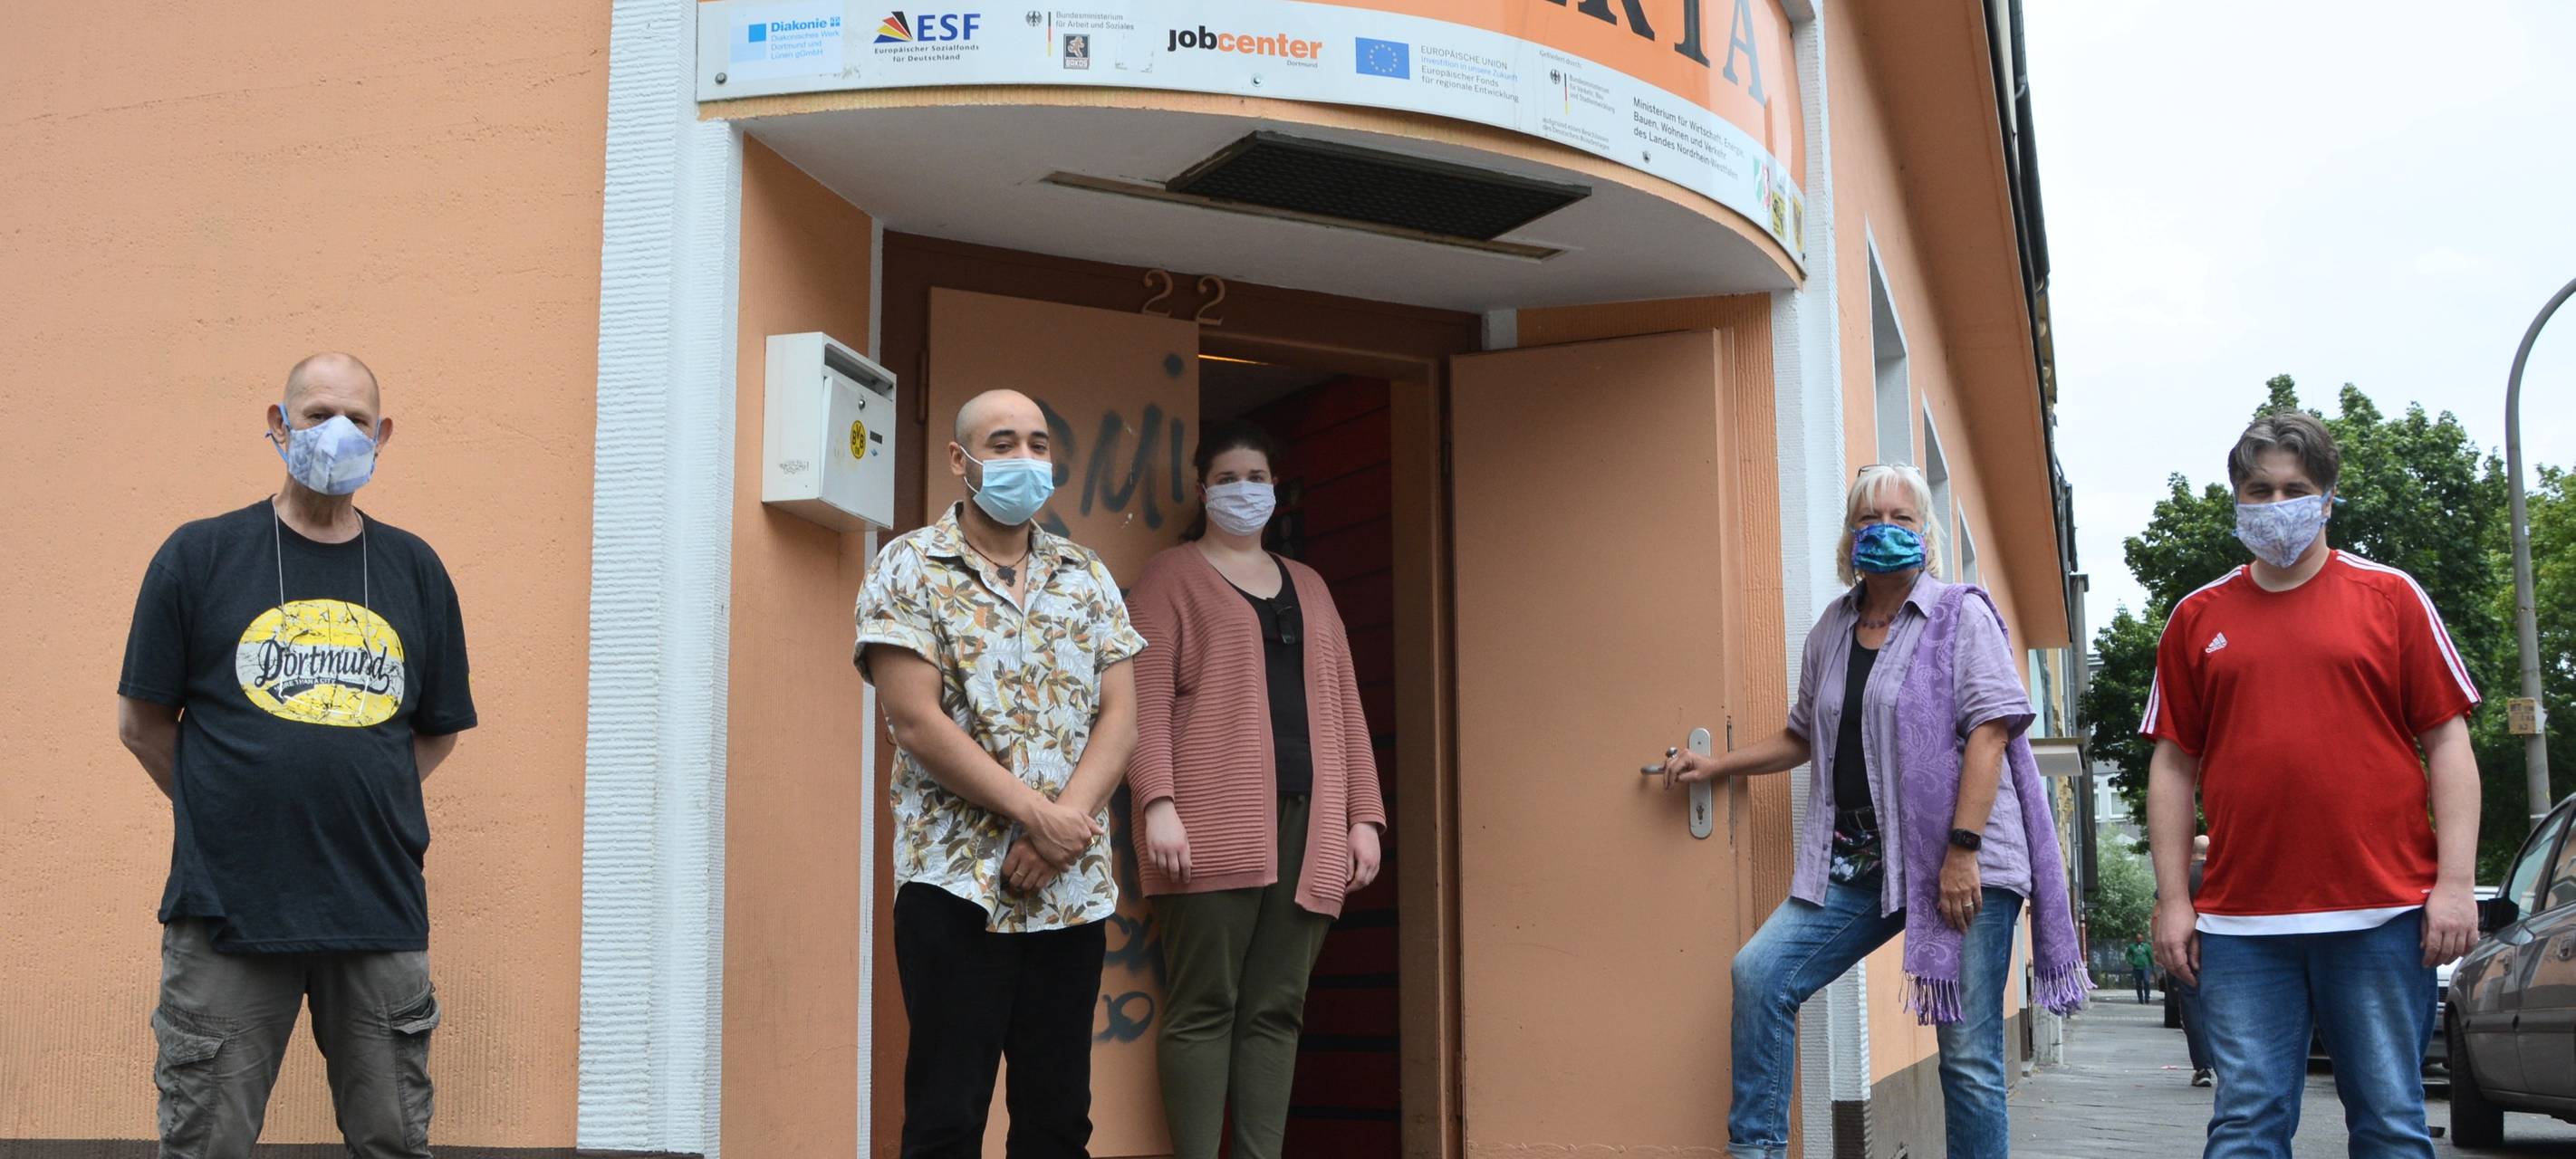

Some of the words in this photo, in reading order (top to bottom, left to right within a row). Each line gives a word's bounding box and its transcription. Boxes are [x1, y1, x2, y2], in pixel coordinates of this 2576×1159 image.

[771, 18, 827, 32] Diakonie
[1056, 11, 1123, 21] Bundesministerium
[1056, 20, 1065, 28] für
[1106, 22, 1134, 30] Soziales
[821, 29, 840, 37] Werk
[917, 14, 981, 42] ESF
[771, 42, 806, 51] Dortmund
[874, 45, 928, 55] Europäischer
[931, 43, 979, 52] Sozialfonds
[1168, 24, 1322, 60] jobcenter
[908, 54, 960, 62] Deutschland
[1286, 60, 1318, 68] Dortmund
[1420, 45, 1479, 64] EUROPÄISCHE
[1481, 57, 1508, 70] UNION
[1421, 65, 1474, 81] Europäischer
[1476, 75, 1499, 87] Fonds
[1421, 75, 1433, 83] für
[1436, 78, 1473, 91] regionale
[1475, 84, 1519, 102] Entwicklung
[1634, 97, 1676, 122] Ministerium
[1677, 115, 1688, 127] für
[1633, 127, 1647, 139] des
[1648, 131, 1675, 150] Landes
[1661, 122, 1689, 141] Wohnen
[1690, 136, 1703, 148] und
[1141, 270, 1226, 326] 22
[255, 630, 389, 694] Dortmund
